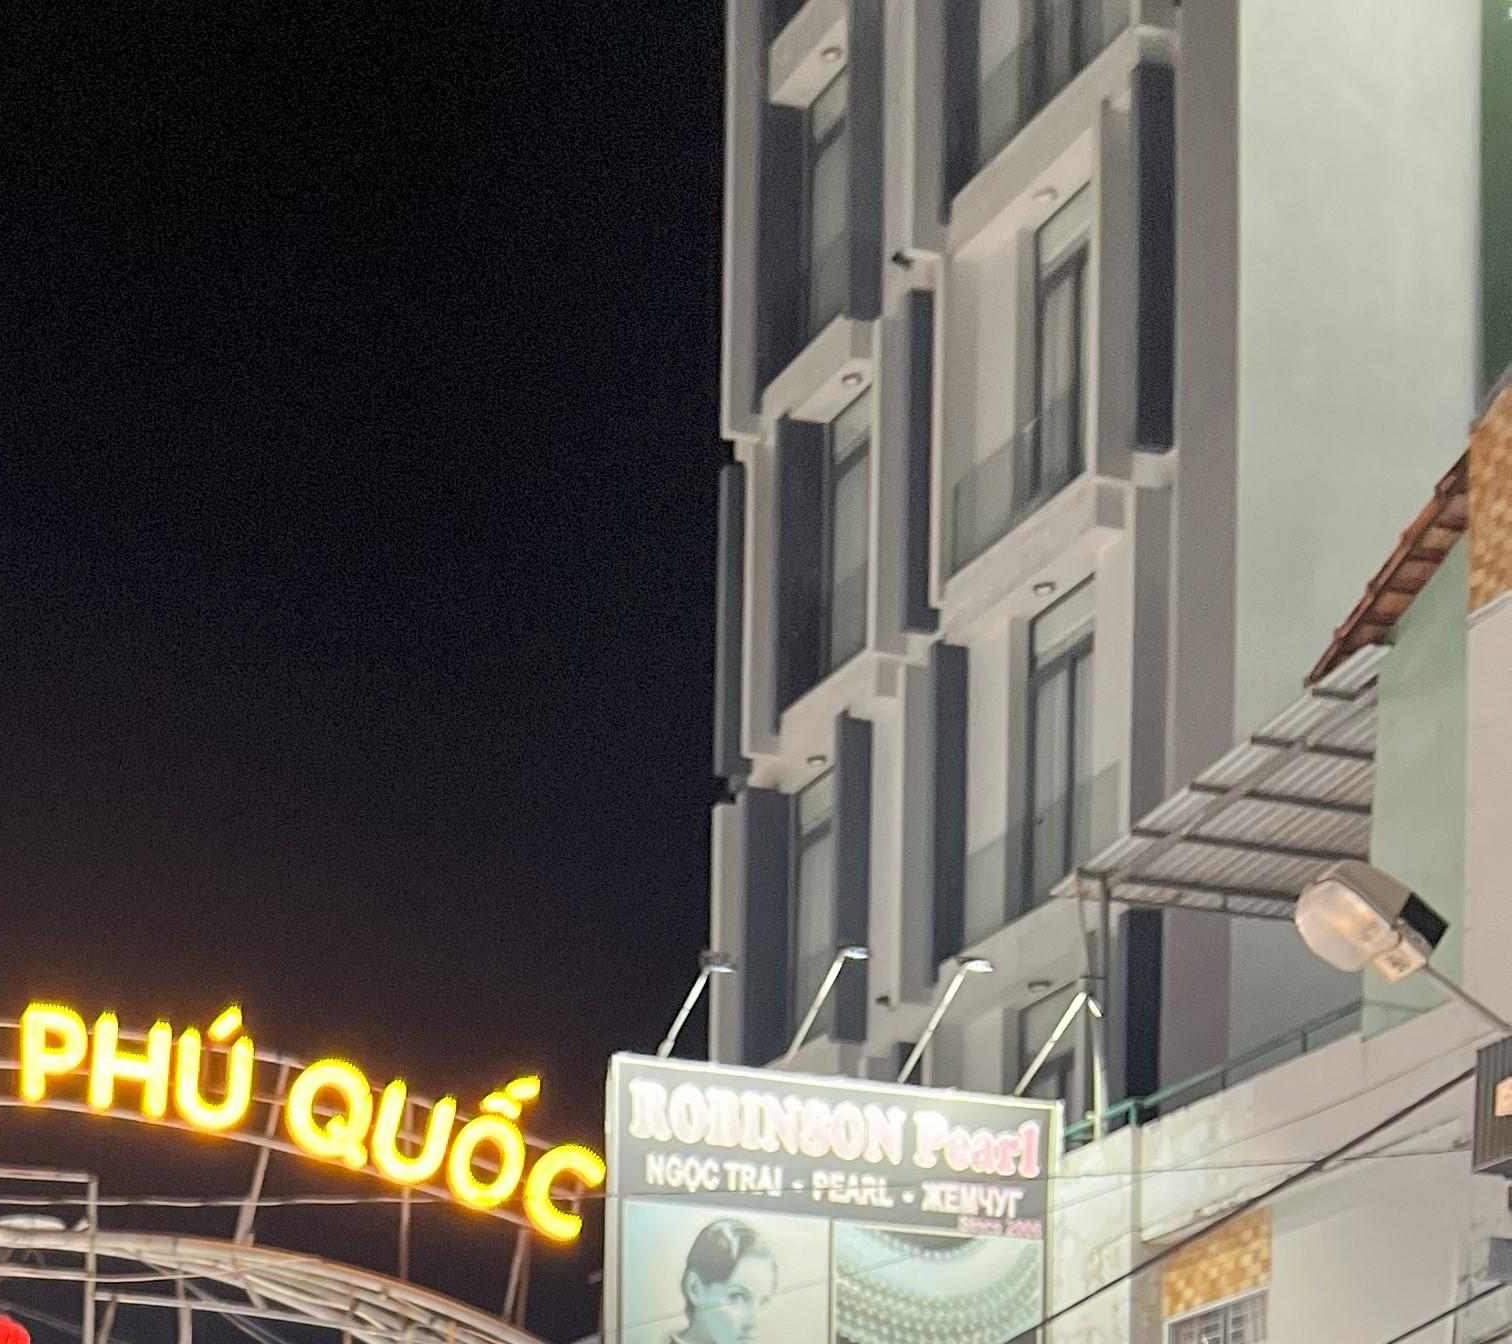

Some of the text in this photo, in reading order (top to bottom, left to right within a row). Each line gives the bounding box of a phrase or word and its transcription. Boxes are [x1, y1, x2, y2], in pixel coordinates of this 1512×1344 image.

[20, 1002, 256, 1132] PHÚ
[285, 1073, 608, 1243] QUỐC
[628, 1078, 1041, 1178] ROBINSON Pearl
[644, 1151, 720, 1192] NGỌC
[811, 1169, 894, 1208] PEARL
